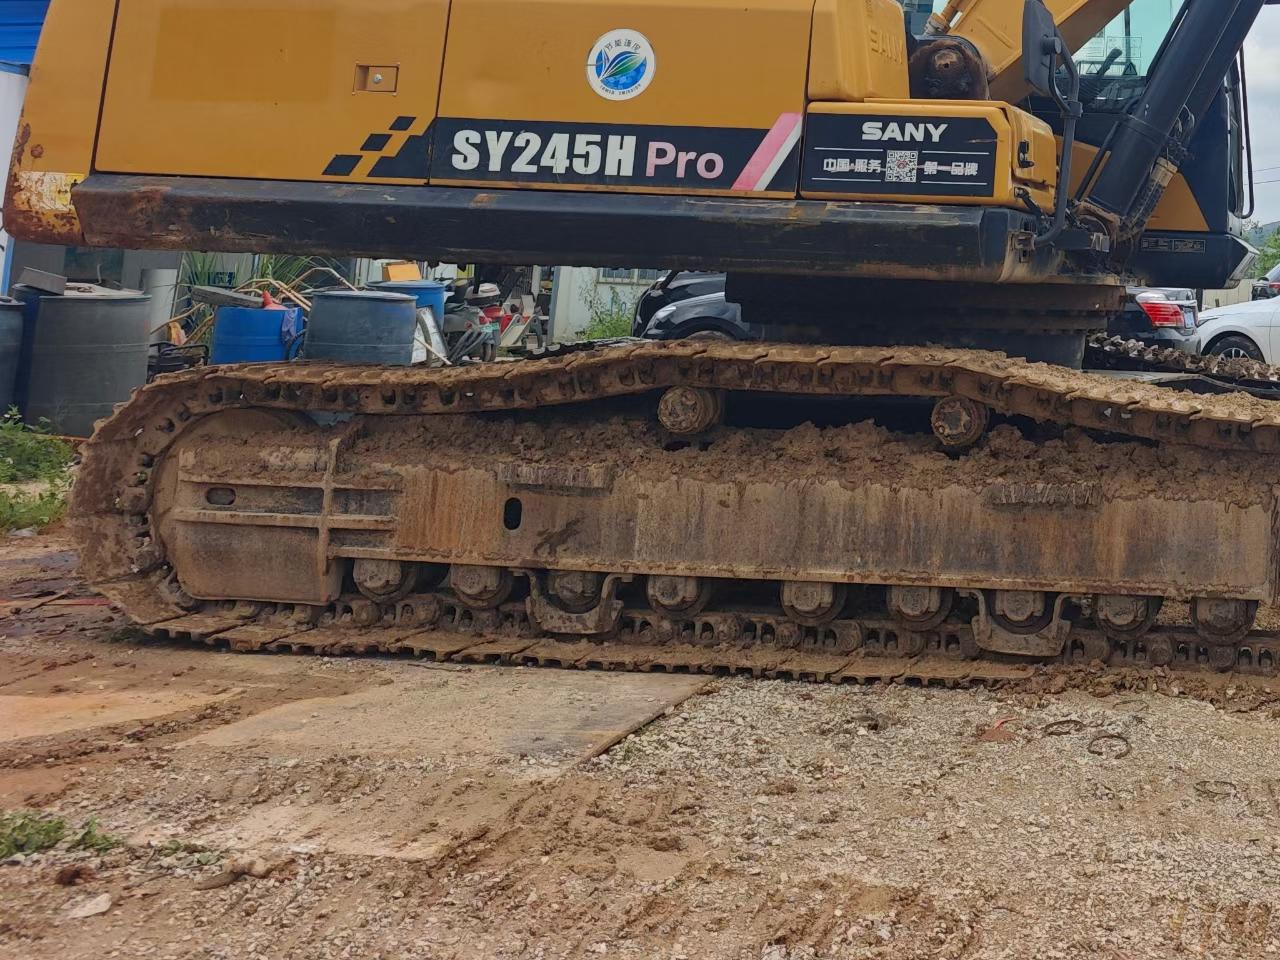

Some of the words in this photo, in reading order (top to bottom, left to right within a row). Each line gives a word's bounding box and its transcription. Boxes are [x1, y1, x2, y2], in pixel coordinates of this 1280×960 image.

[861, 121, 948, 143] SANY
[451, 129, 637, 176] SY245H
[645, 141, 724, 179] Pro
